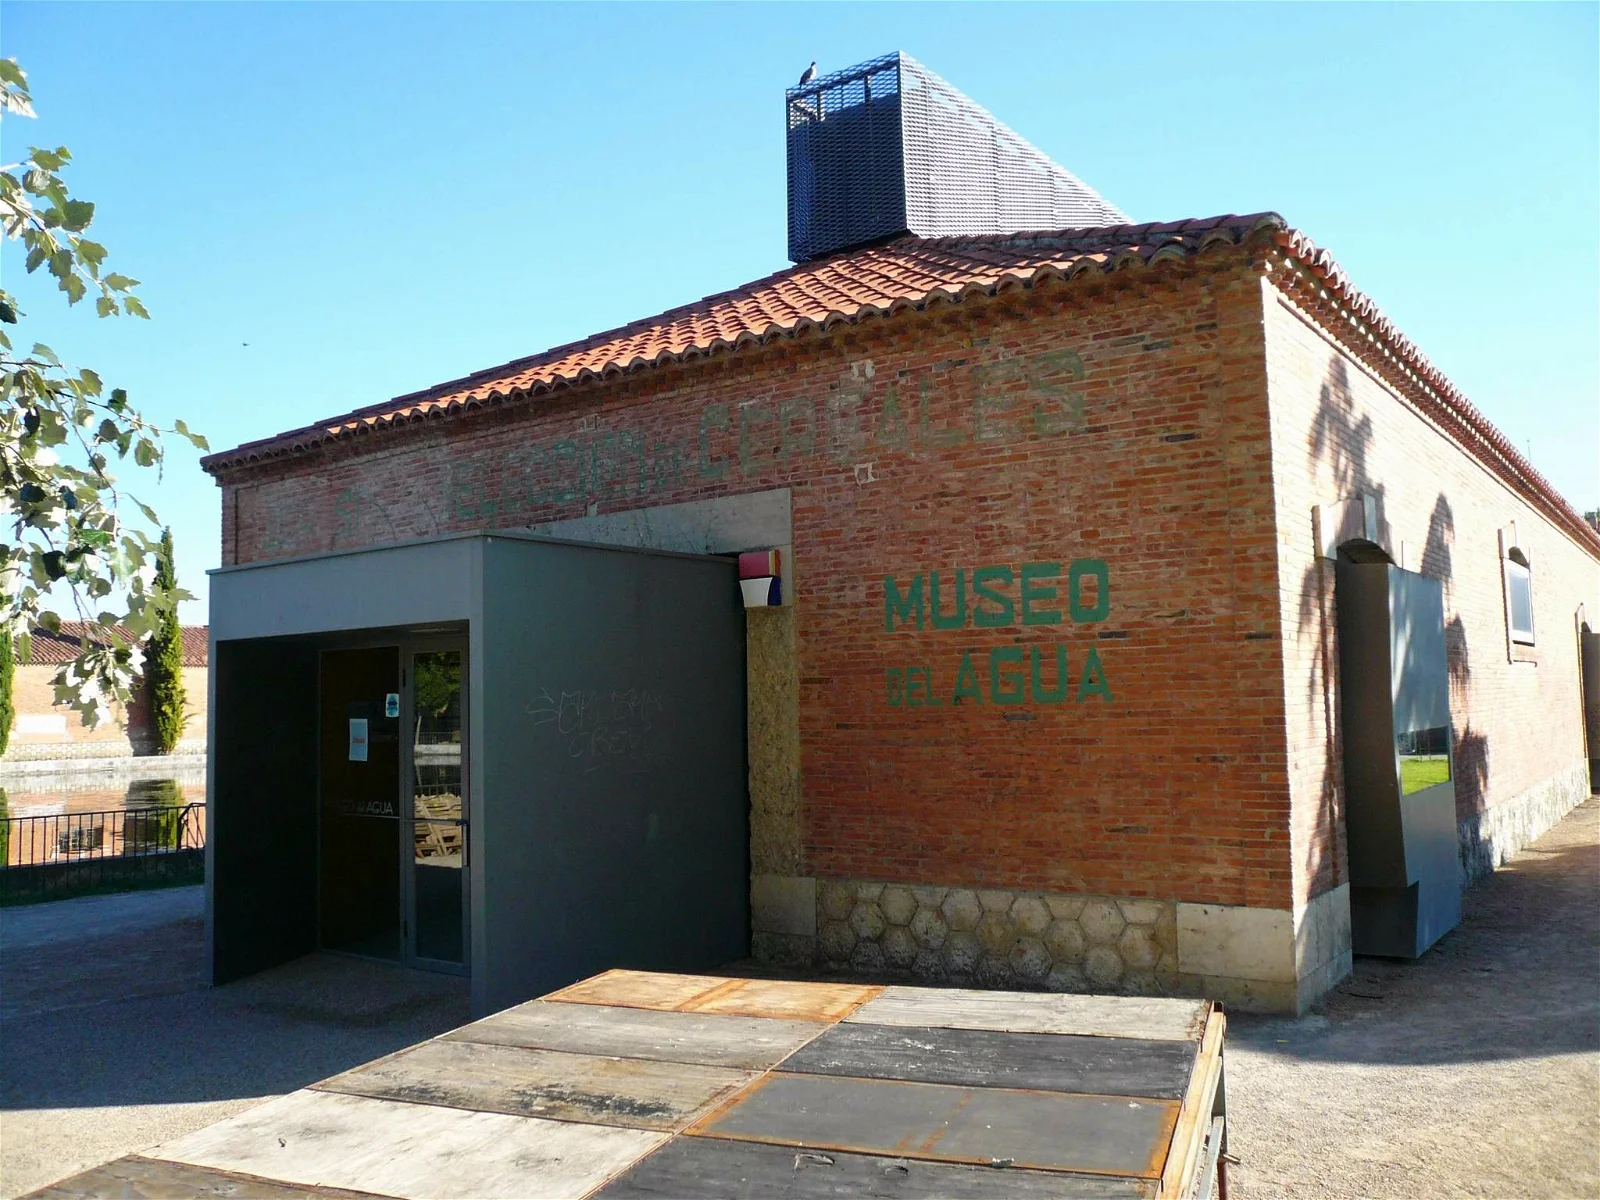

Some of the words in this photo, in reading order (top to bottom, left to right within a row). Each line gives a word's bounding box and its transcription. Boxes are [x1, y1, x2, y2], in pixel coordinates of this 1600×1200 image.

[883, 558, 1110, 633] MUSEO
[886, 665, 944, 707] DEL
[950, 642, 1113, 706] AGUA
[365, 799, 394, 816] AGUA
